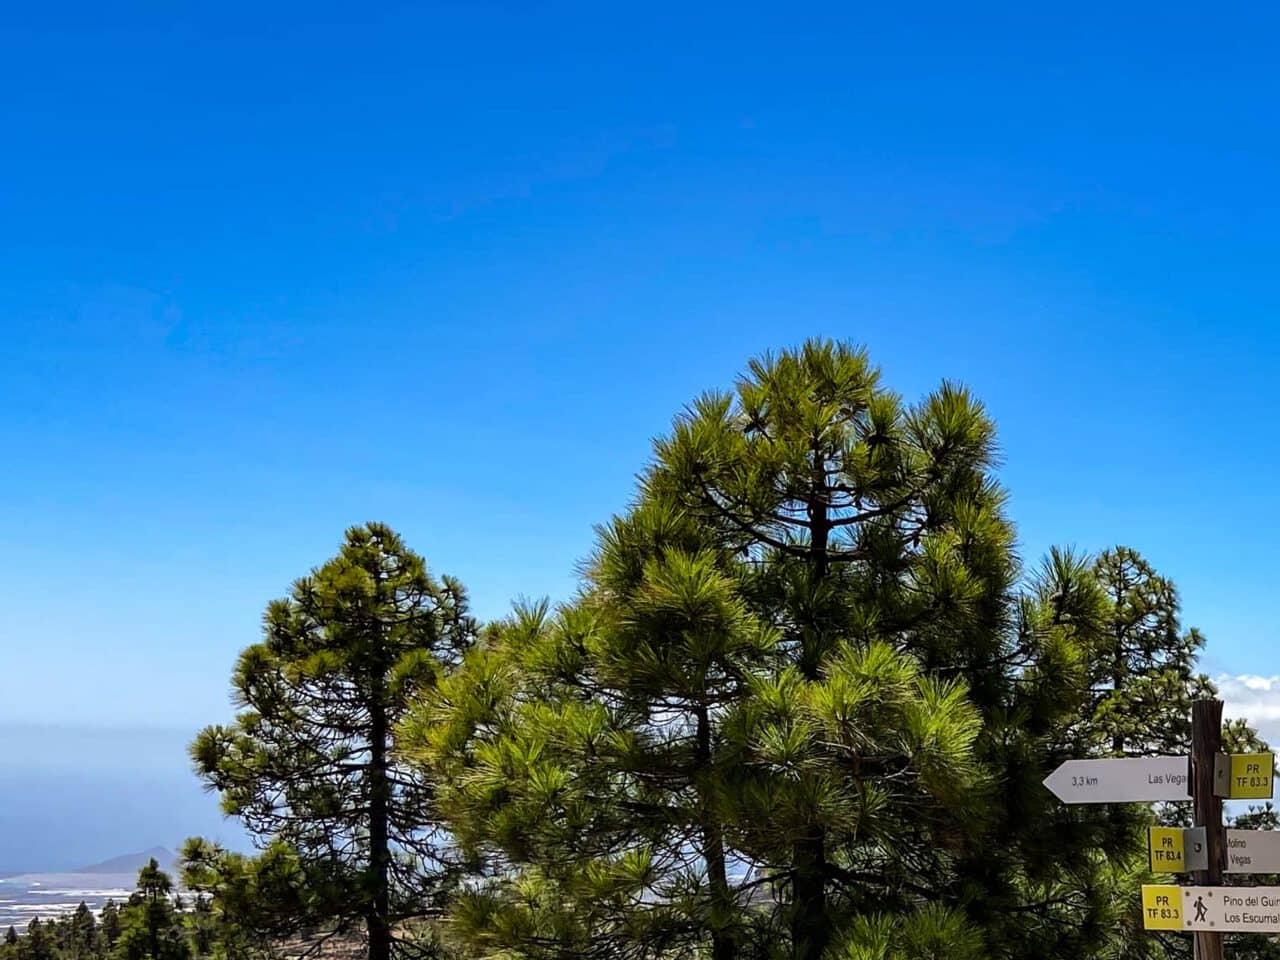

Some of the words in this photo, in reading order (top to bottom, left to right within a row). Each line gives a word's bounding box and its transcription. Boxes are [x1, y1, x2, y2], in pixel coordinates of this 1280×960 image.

[1246, 764, 1260, 774] PR
[1086, 775, 1098, 786] km
[1148, 773, 1163, 784] Las
[1165, 773, 1187, 786] Vega
[1236, 777, 1248, 787] TF
[1249, 776, 1269, 787] 83.3
[1162, 837, 1173, 847] PR
[1154, 850, 1165, 861] TF
[1166, 850, 1182, 861] 83.4
[1230, 854, 1252, 867] Vegas
[1155, 896, 1169, 906] PR
[1223, 895, 1243, 906] Pino
[1245, 895, 1259, 906] del
[1146, 908, 1159, 919] TF
[1160, 908, 1179, 919] 83.3
[1224, 912, 1241, 924] Los
